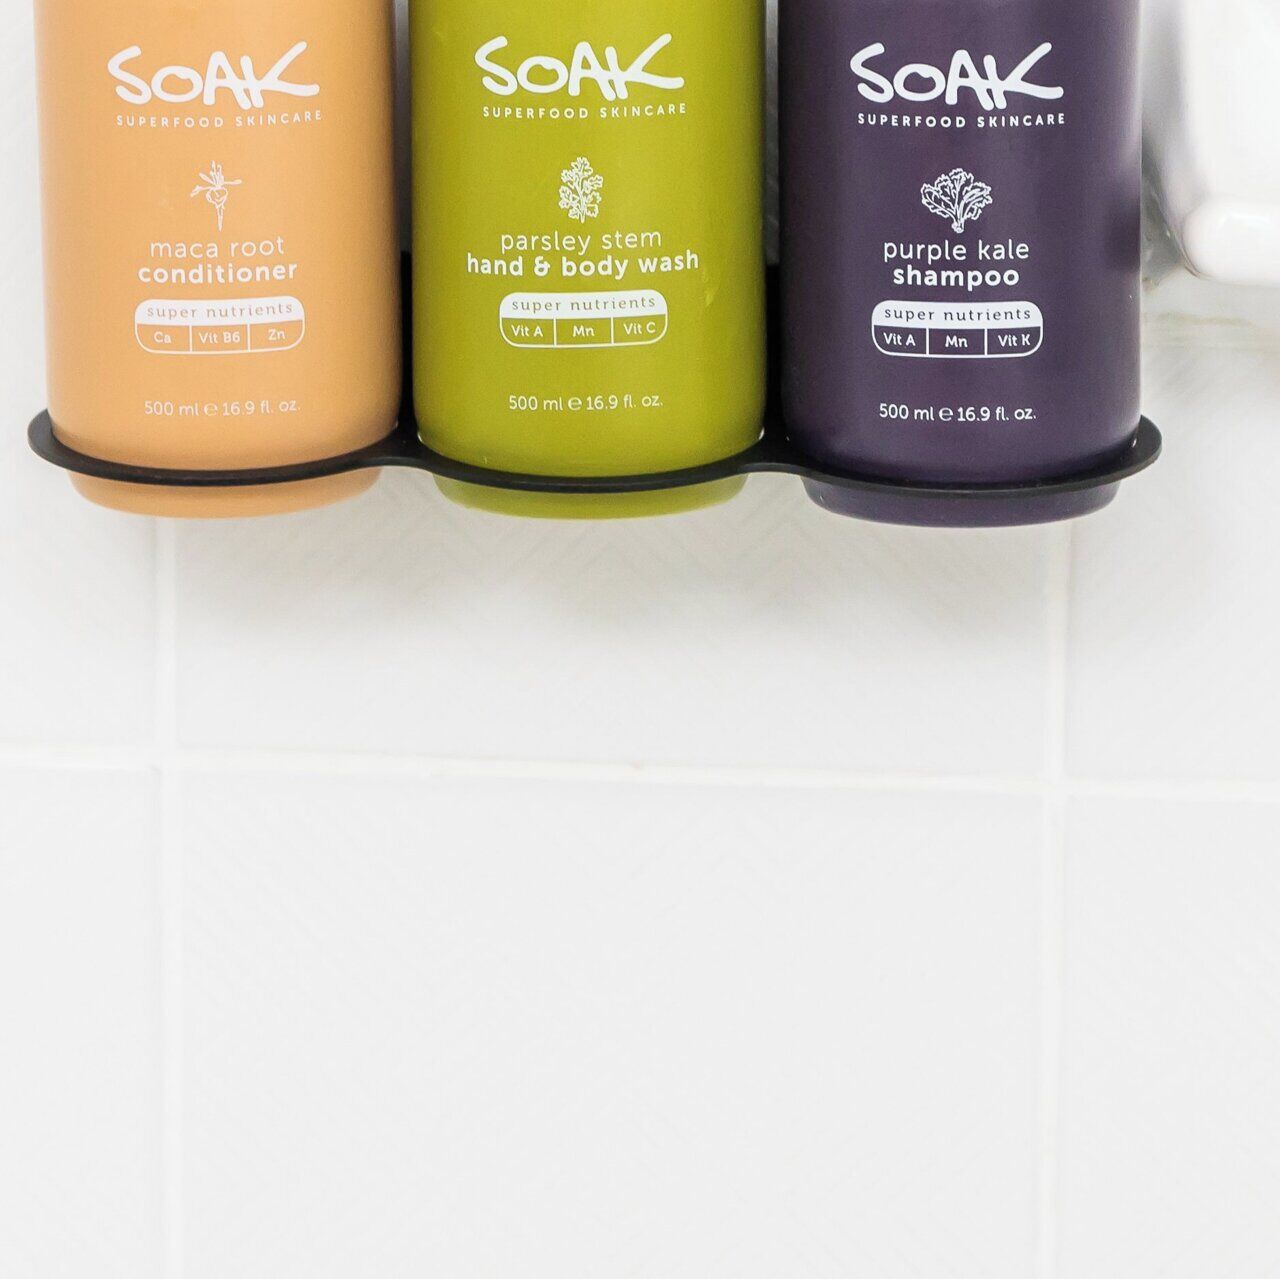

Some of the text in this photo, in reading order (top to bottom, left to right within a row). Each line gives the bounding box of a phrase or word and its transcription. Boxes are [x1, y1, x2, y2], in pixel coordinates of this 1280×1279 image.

[474, 33, 684, 101] SOAK
[107, 41, 320, 110] SOAK
[850, 42, 1064, 111] SOAK
[116, 110, 322, 128] SUPERFOOD SKINCARE
[482, 103, 687, 119] SUPERFOOD SKINCARE
[858, 113, 1065, 128] SUPERFOOD SKINCARE
[150, 237, 284, 259] maca root
[501, 230, 662, 255] parsley stem
[884, 239, 1029, 262] purple kale
[138, 262, 298, 284] conditioner
[467, 250, 699, 280] hand & body wash
[893, 265, 1019, 291] shampoo
[147, 302, 293, 319] super nutrients
[512, 296, 656, 312] super nutrients
[884, 307, 1030, 322] super nutrients
[268, 329, 285, 341] Zn
[511, 324, 543, 337] Vit A
[573, 324, 594, 337] Mn
[623, 321, 656, 335] Vit C
[154, 331, 171, 343] Ca
[198, 330, 240, 343] Vit B6
[884, 333, 916, 346] Vit A
[945, 335, 968, 348] Mn
[998, 333, 1030, 346] Vit K
[144, 401, 174, 416] 500
[179, 401, 198, 416] ml
[222, 401, 254, 416] 16.9
[260, 400, 275, 414] fl.
[279, 400, 300, 412] oz.
[509, 396, 538, 410] 500
[544, 396, 563, 411] ml
[586, 395, 618, 410] 16.9
[623, 394, 637, 408] fl.
[642, 395, 663, 407] oz.
[879, 404, 909, 419] 500
[914, 406, 934, 421] ml
[958, 407, 990, 421] 16.9
[996, 406, 1009, 420] fl.
[1014, 408, 1036, 419] oz.
